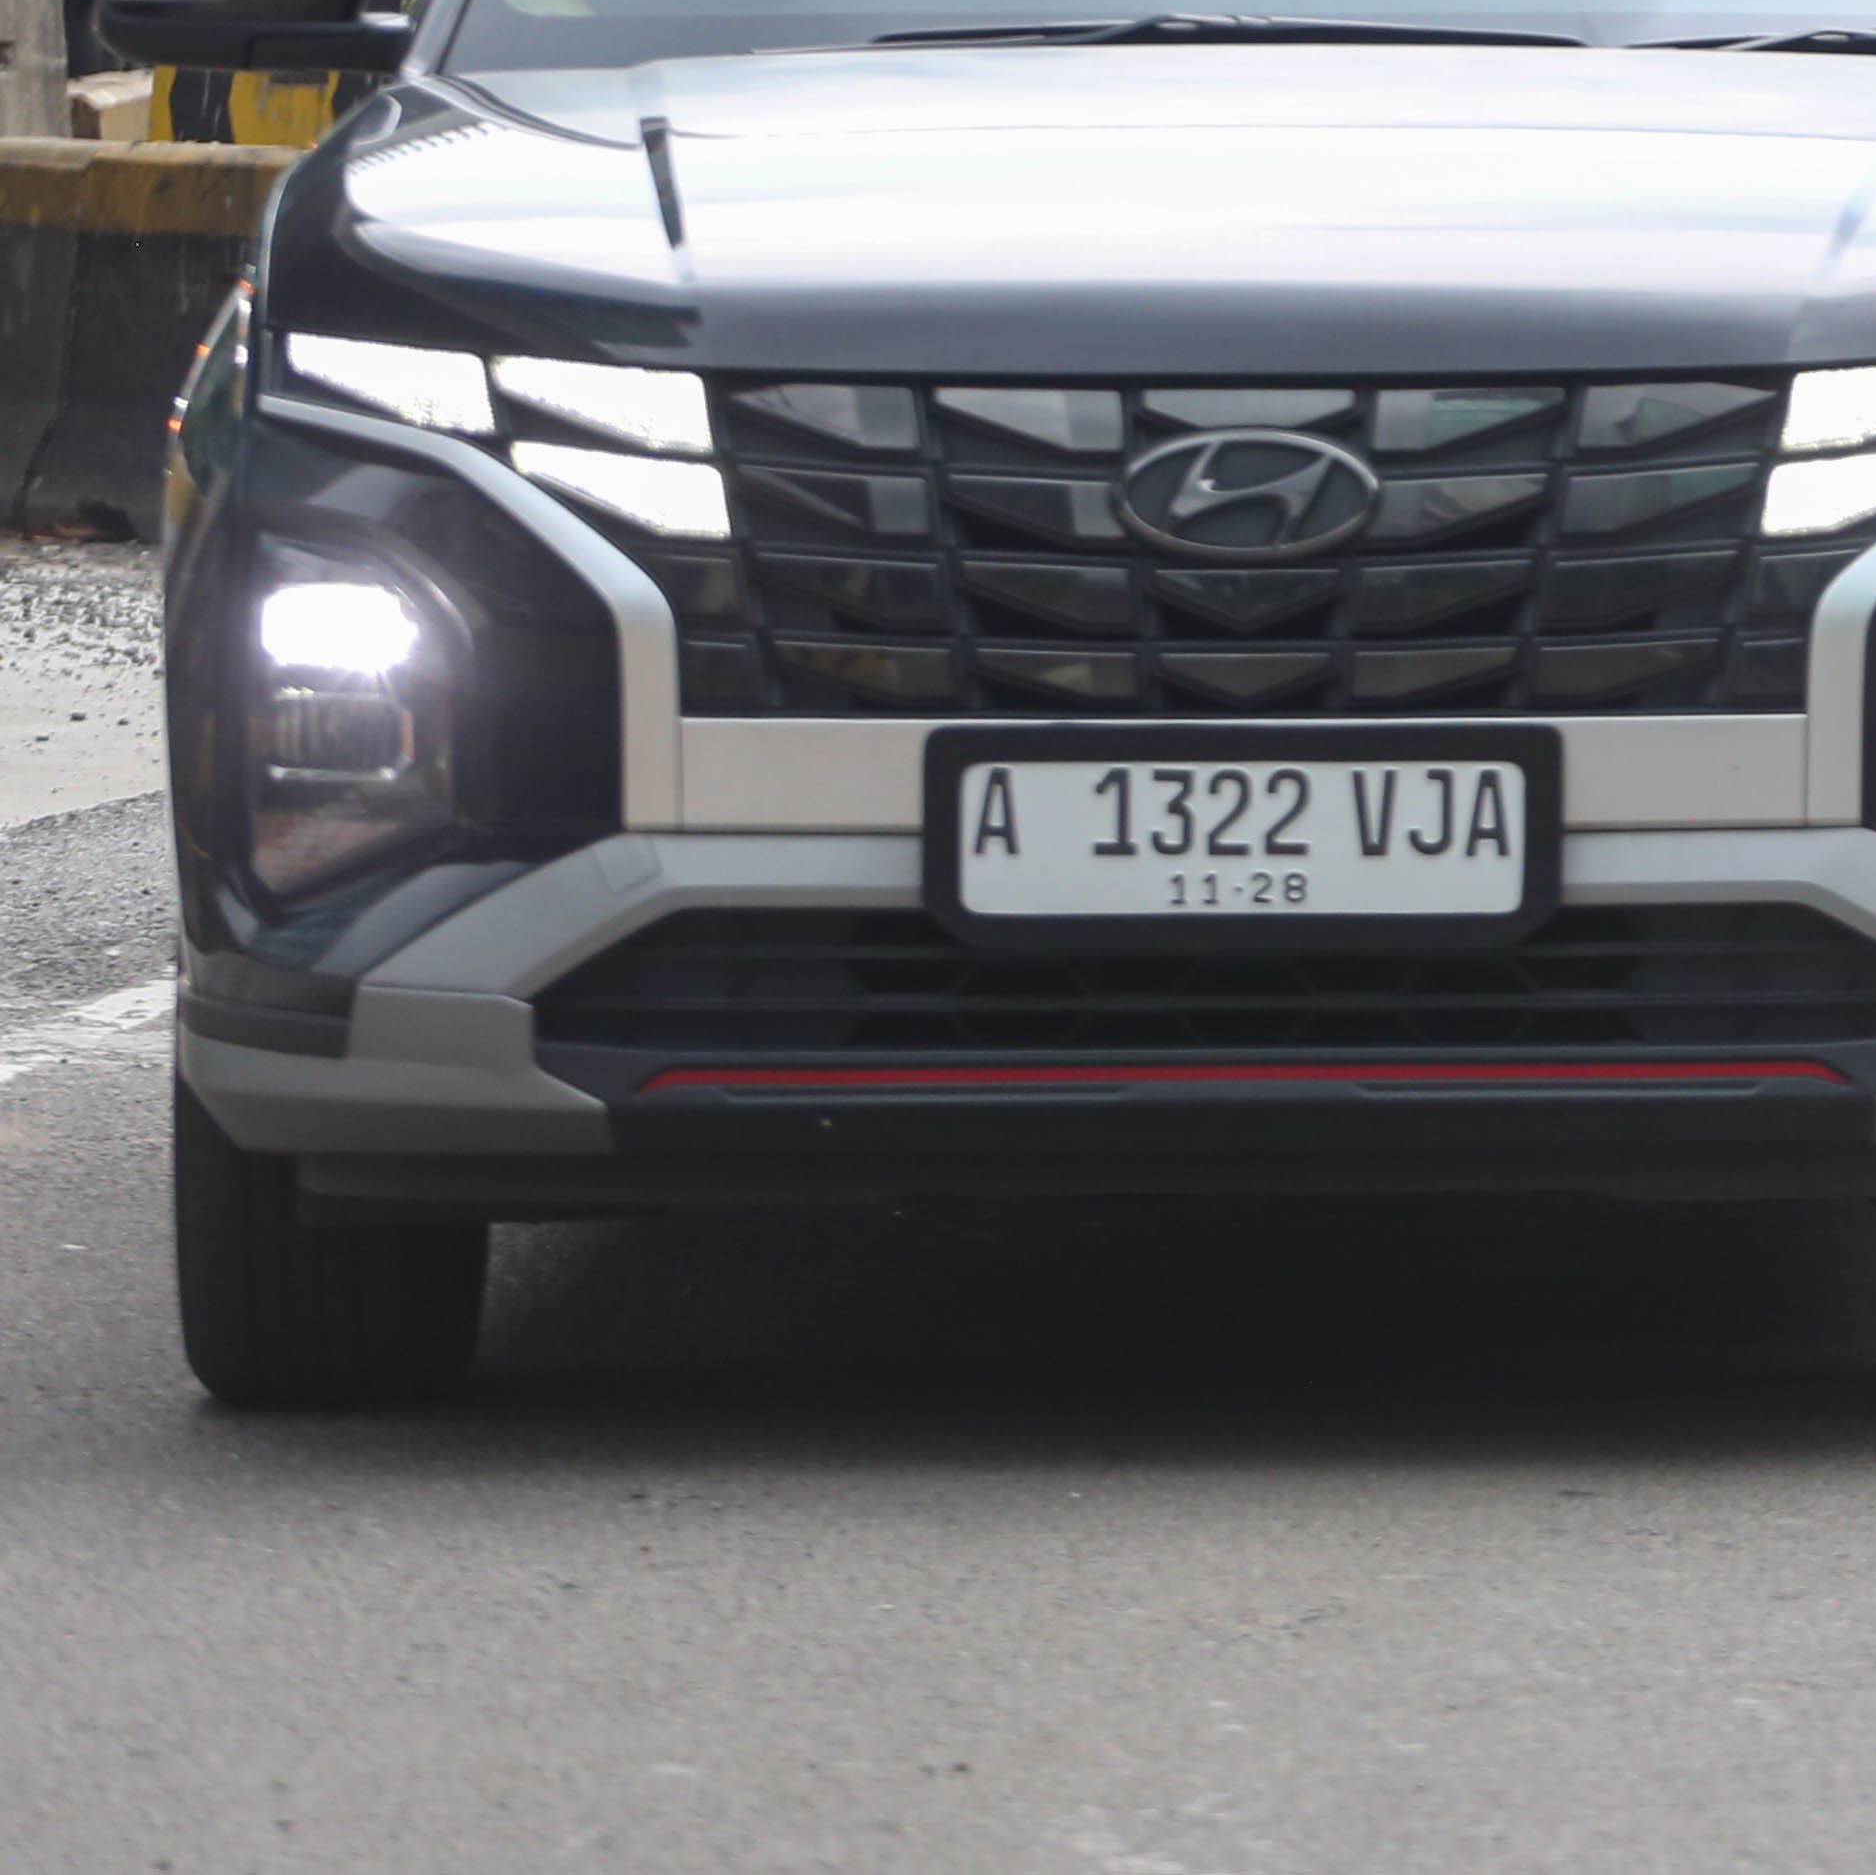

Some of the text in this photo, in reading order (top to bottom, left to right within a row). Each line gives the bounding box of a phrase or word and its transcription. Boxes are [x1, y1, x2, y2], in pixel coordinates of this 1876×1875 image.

[974, 766, 1511, 858] A 1322 VJA
